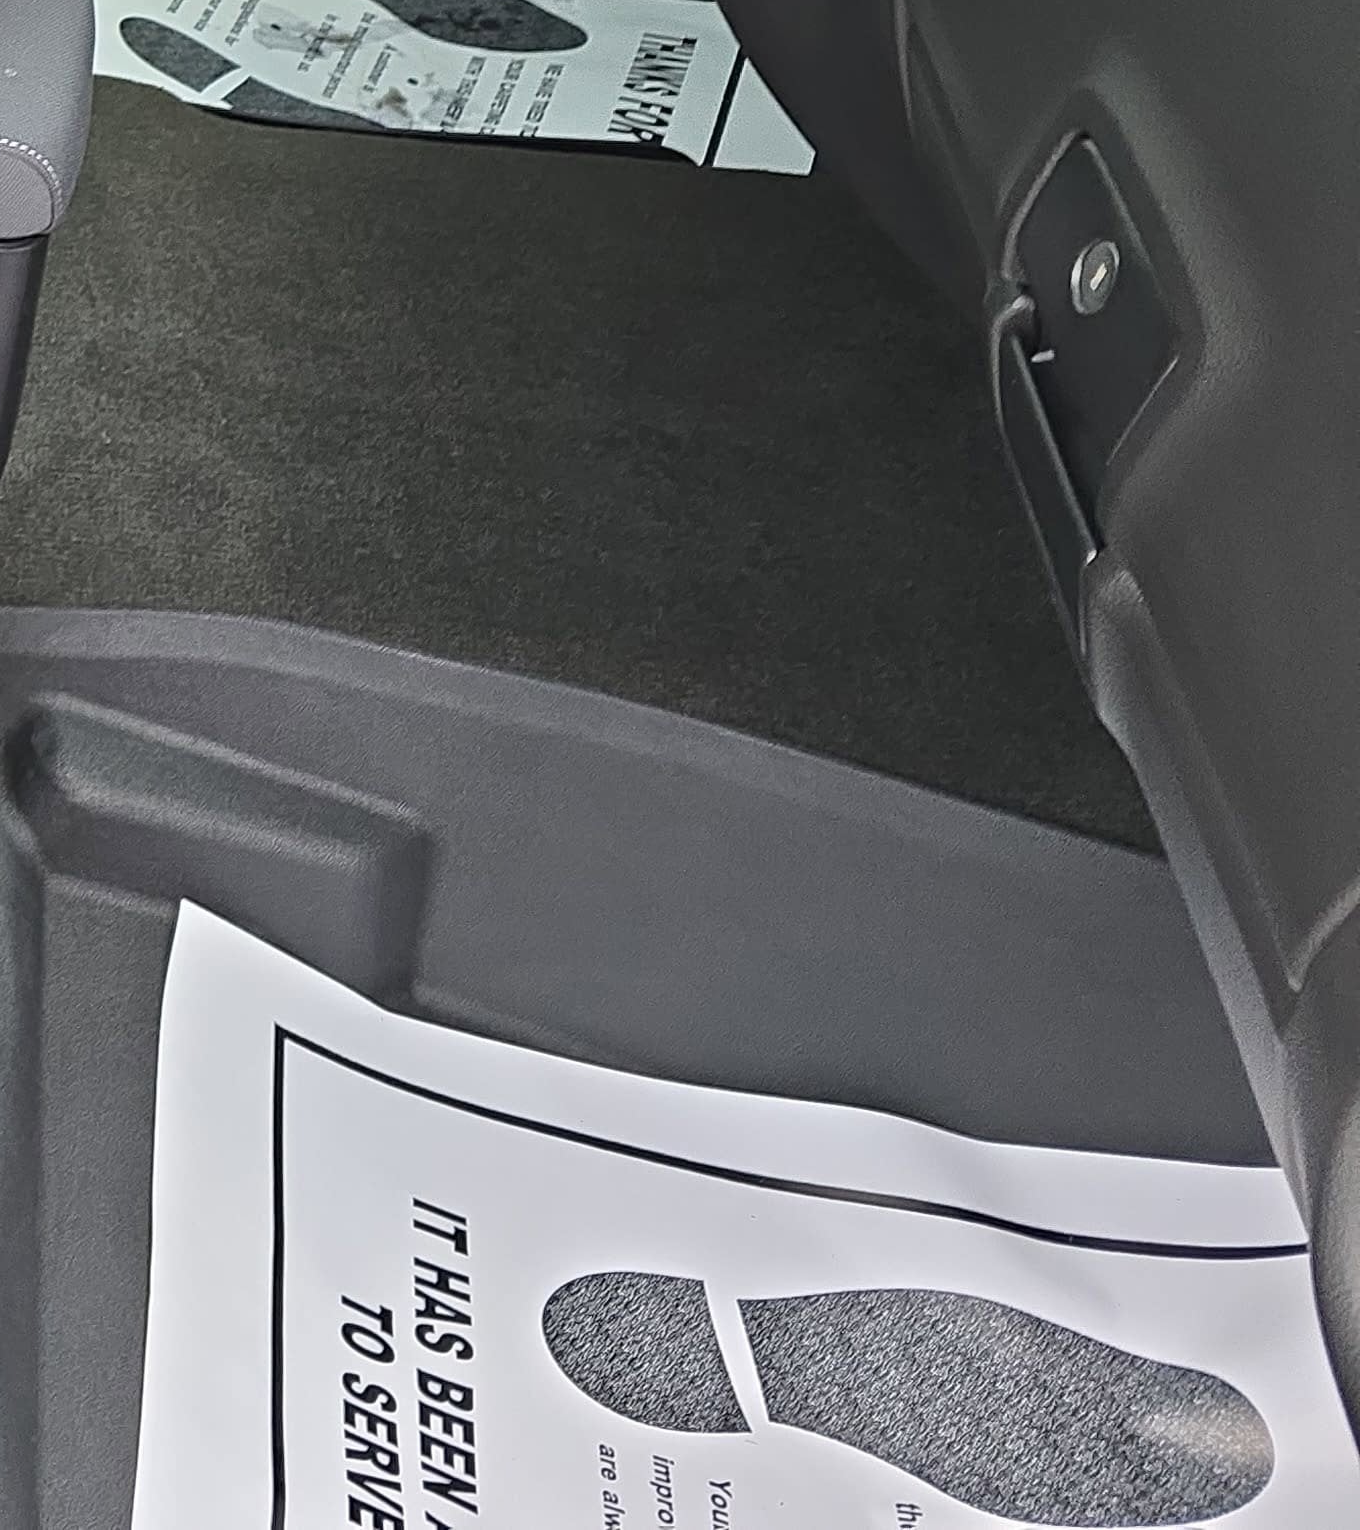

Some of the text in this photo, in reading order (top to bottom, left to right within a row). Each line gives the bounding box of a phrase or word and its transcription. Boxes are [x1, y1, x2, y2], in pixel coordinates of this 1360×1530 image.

[607, 33, 697, 145] THANKS FOR
[412, 1197, 469, 1256] IT
[413, 1256, 475, 1361] HAS
[341, 1294, 406, 1530] TO SERVE
[416, 1367, 480, 1516] BEEN
[599, 1444, 617, 1481] are
